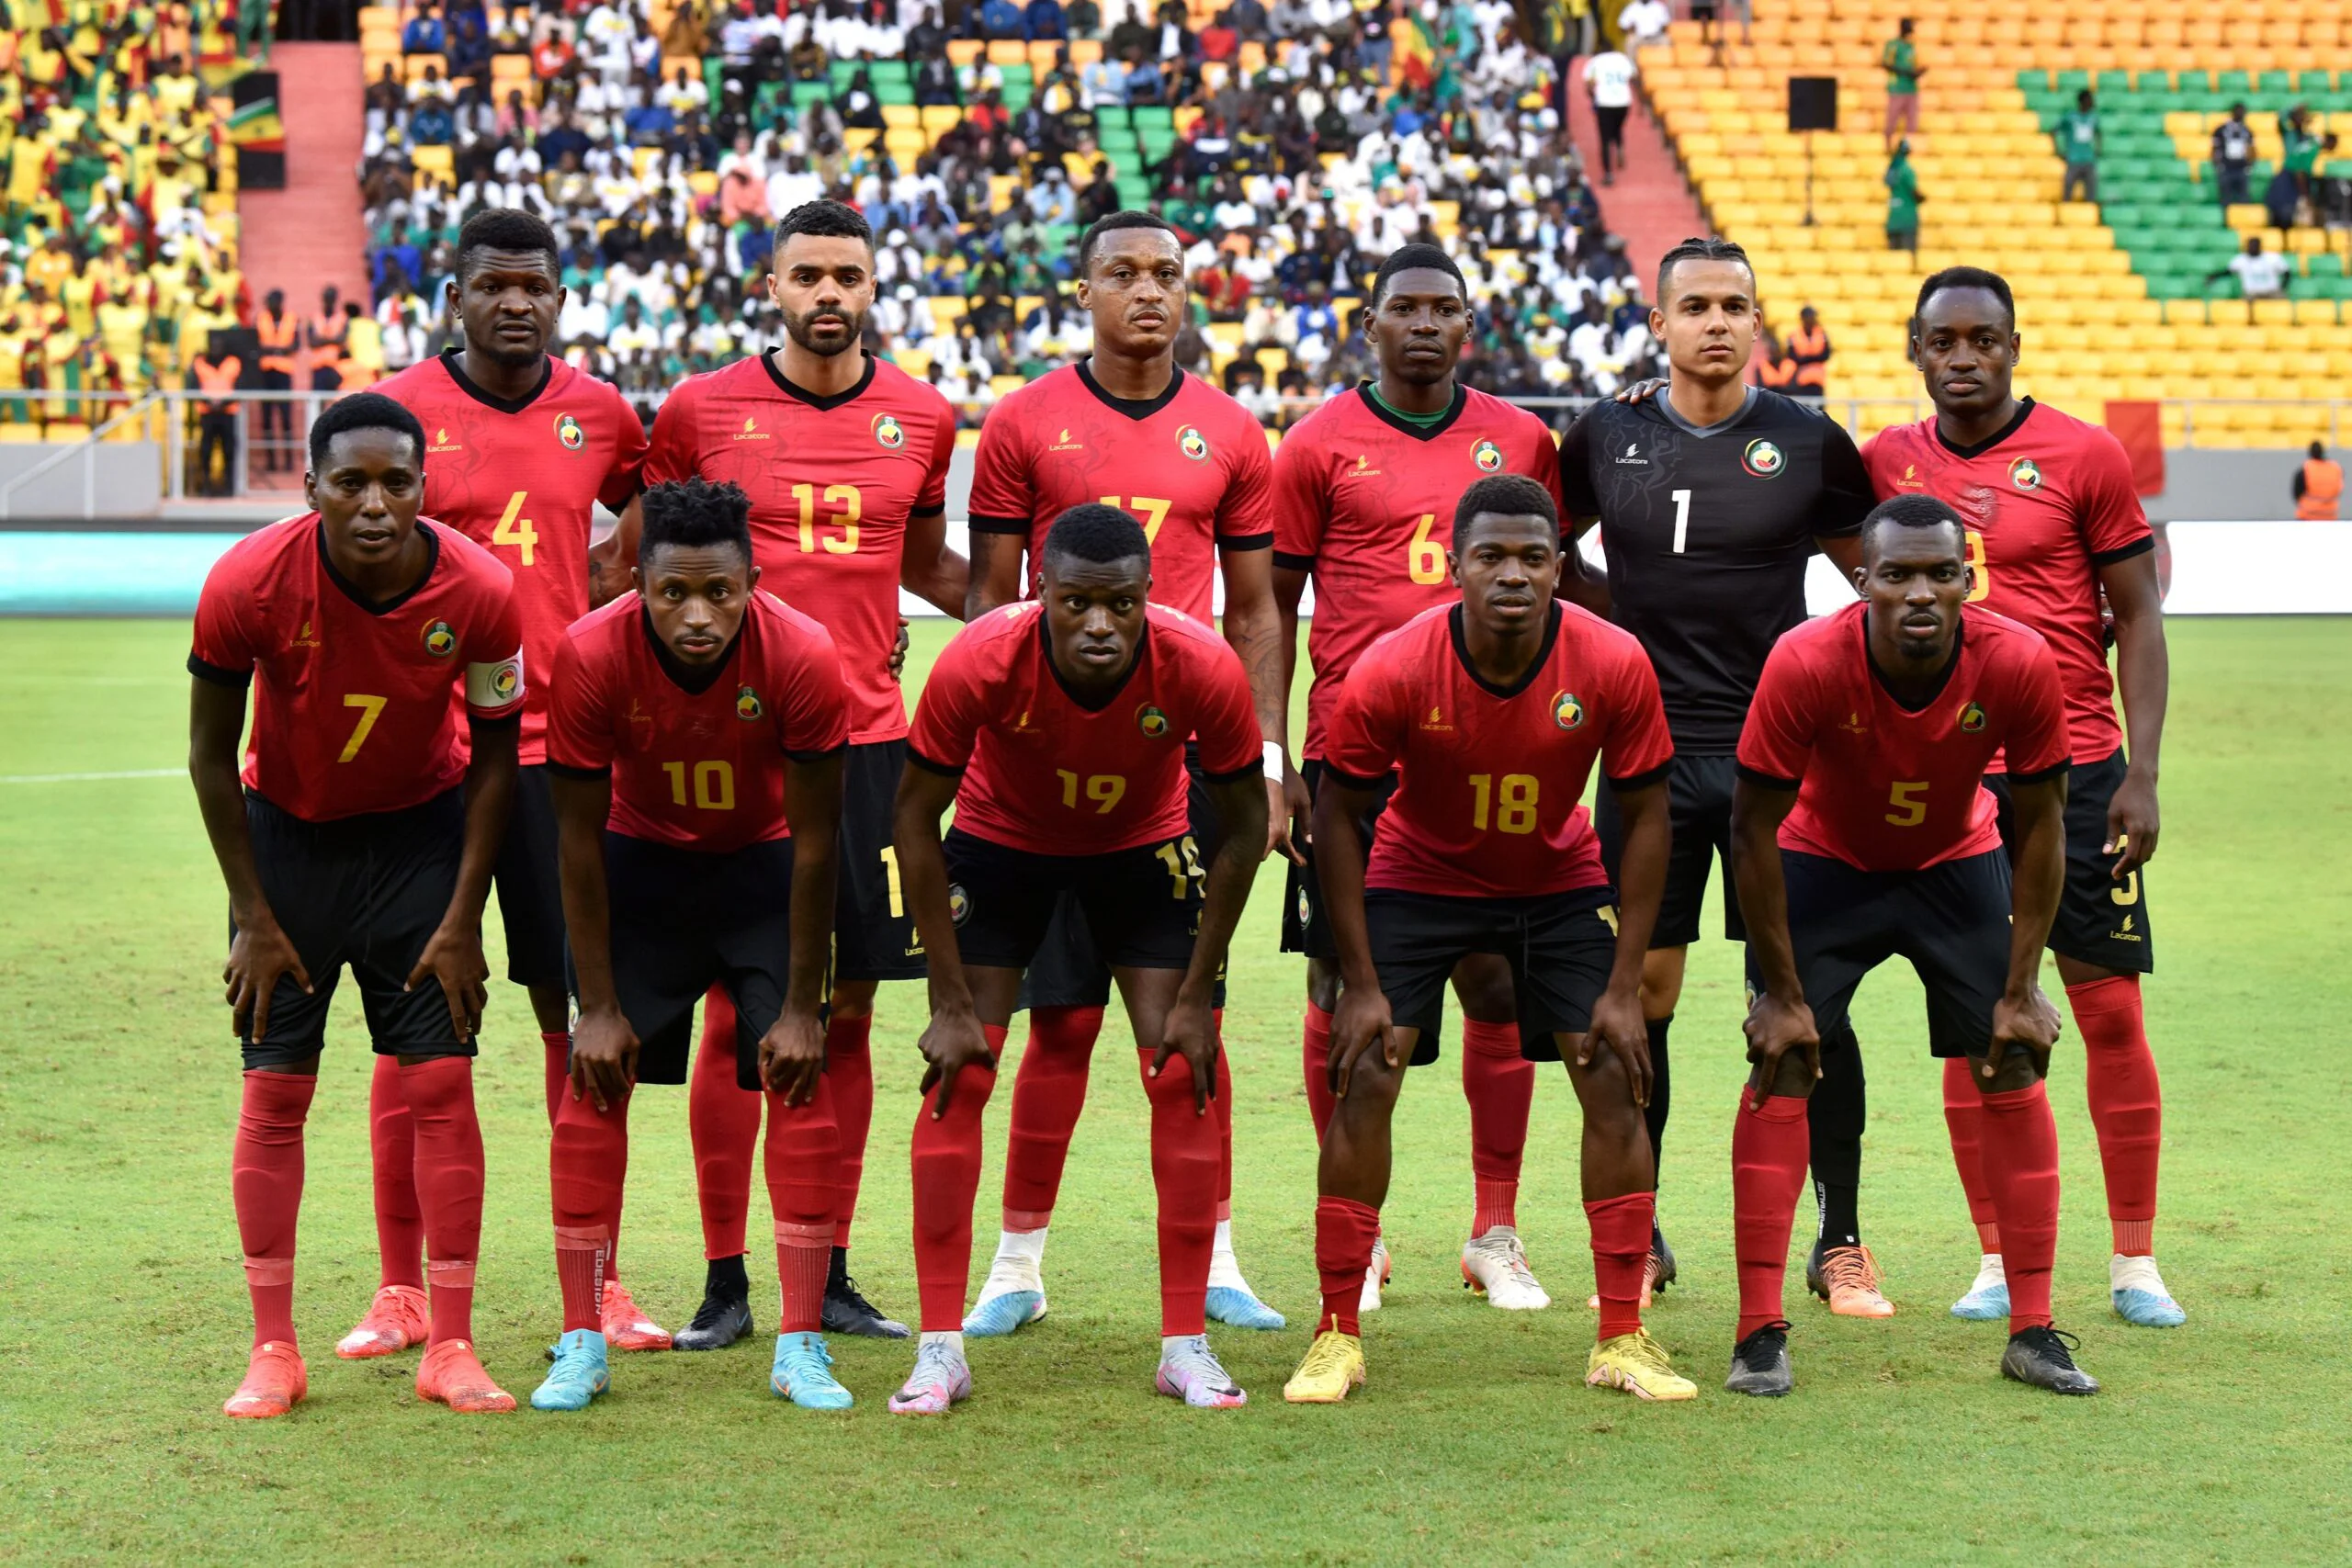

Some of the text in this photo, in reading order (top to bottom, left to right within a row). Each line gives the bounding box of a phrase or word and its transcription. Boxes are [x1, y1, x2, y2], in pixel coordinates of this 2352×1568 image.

[492, 491, 538, 567] 4
[791, 483, 862, 555] 13
[1099, 495, 1172, 547] 7
[1408, 513, 1446, 585] 6
[1671, 489, 1692, 554] 1
[337, 694, 388, 762] 7
[662, 760, 735, 810] 10
[1057, 768, 1126, 815] 19
[1469, 773, 1540, 835] 18
[1884, 781, 1929, 827] 5
